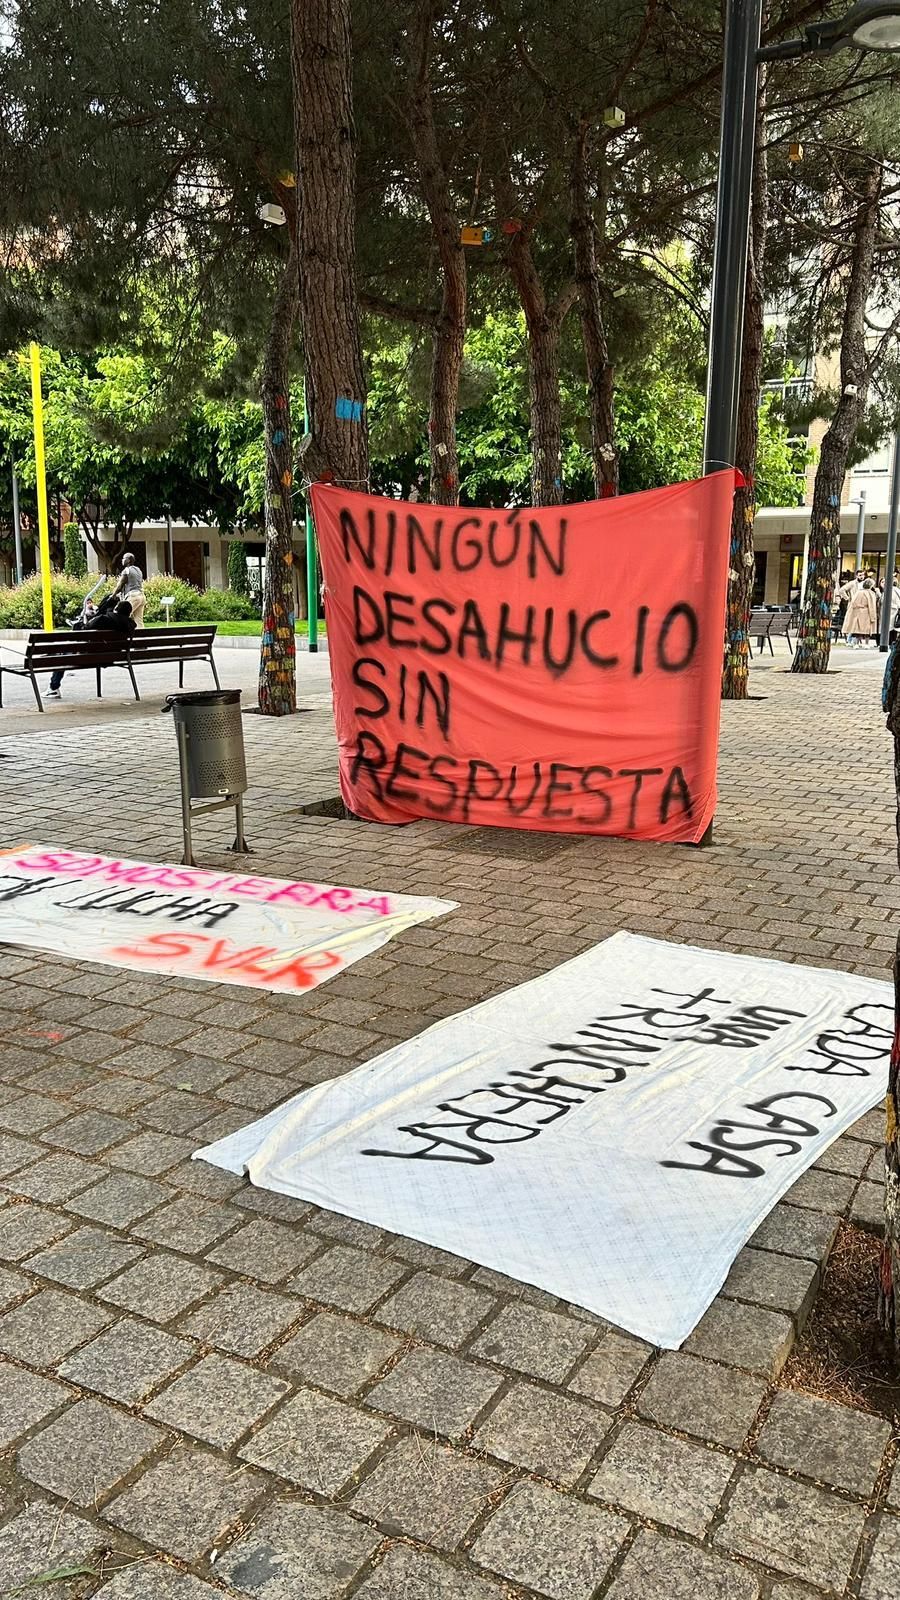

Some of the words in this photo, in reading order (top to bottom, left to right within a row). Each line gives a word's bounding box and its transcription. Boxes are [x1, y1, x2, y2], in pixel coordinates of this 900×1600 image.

[338, 508, 570, 578] NINGÚN
[352, 585, 701, 678] DESAHUCIO
[352, 657, 450, 742] SIN
[350, 730, 695, 829] RESPUESTA
[16, 852, 391, 916] SOMOSIERRA
[53, 884, 239, 928] LUCHA
[672, 1005, 807, 1048] UNA
[783, 1003, 896, 1076] CADA
[360, 987, 732, 1165] TRINCHERA
[660, 1092, 837, 1178] CASA
